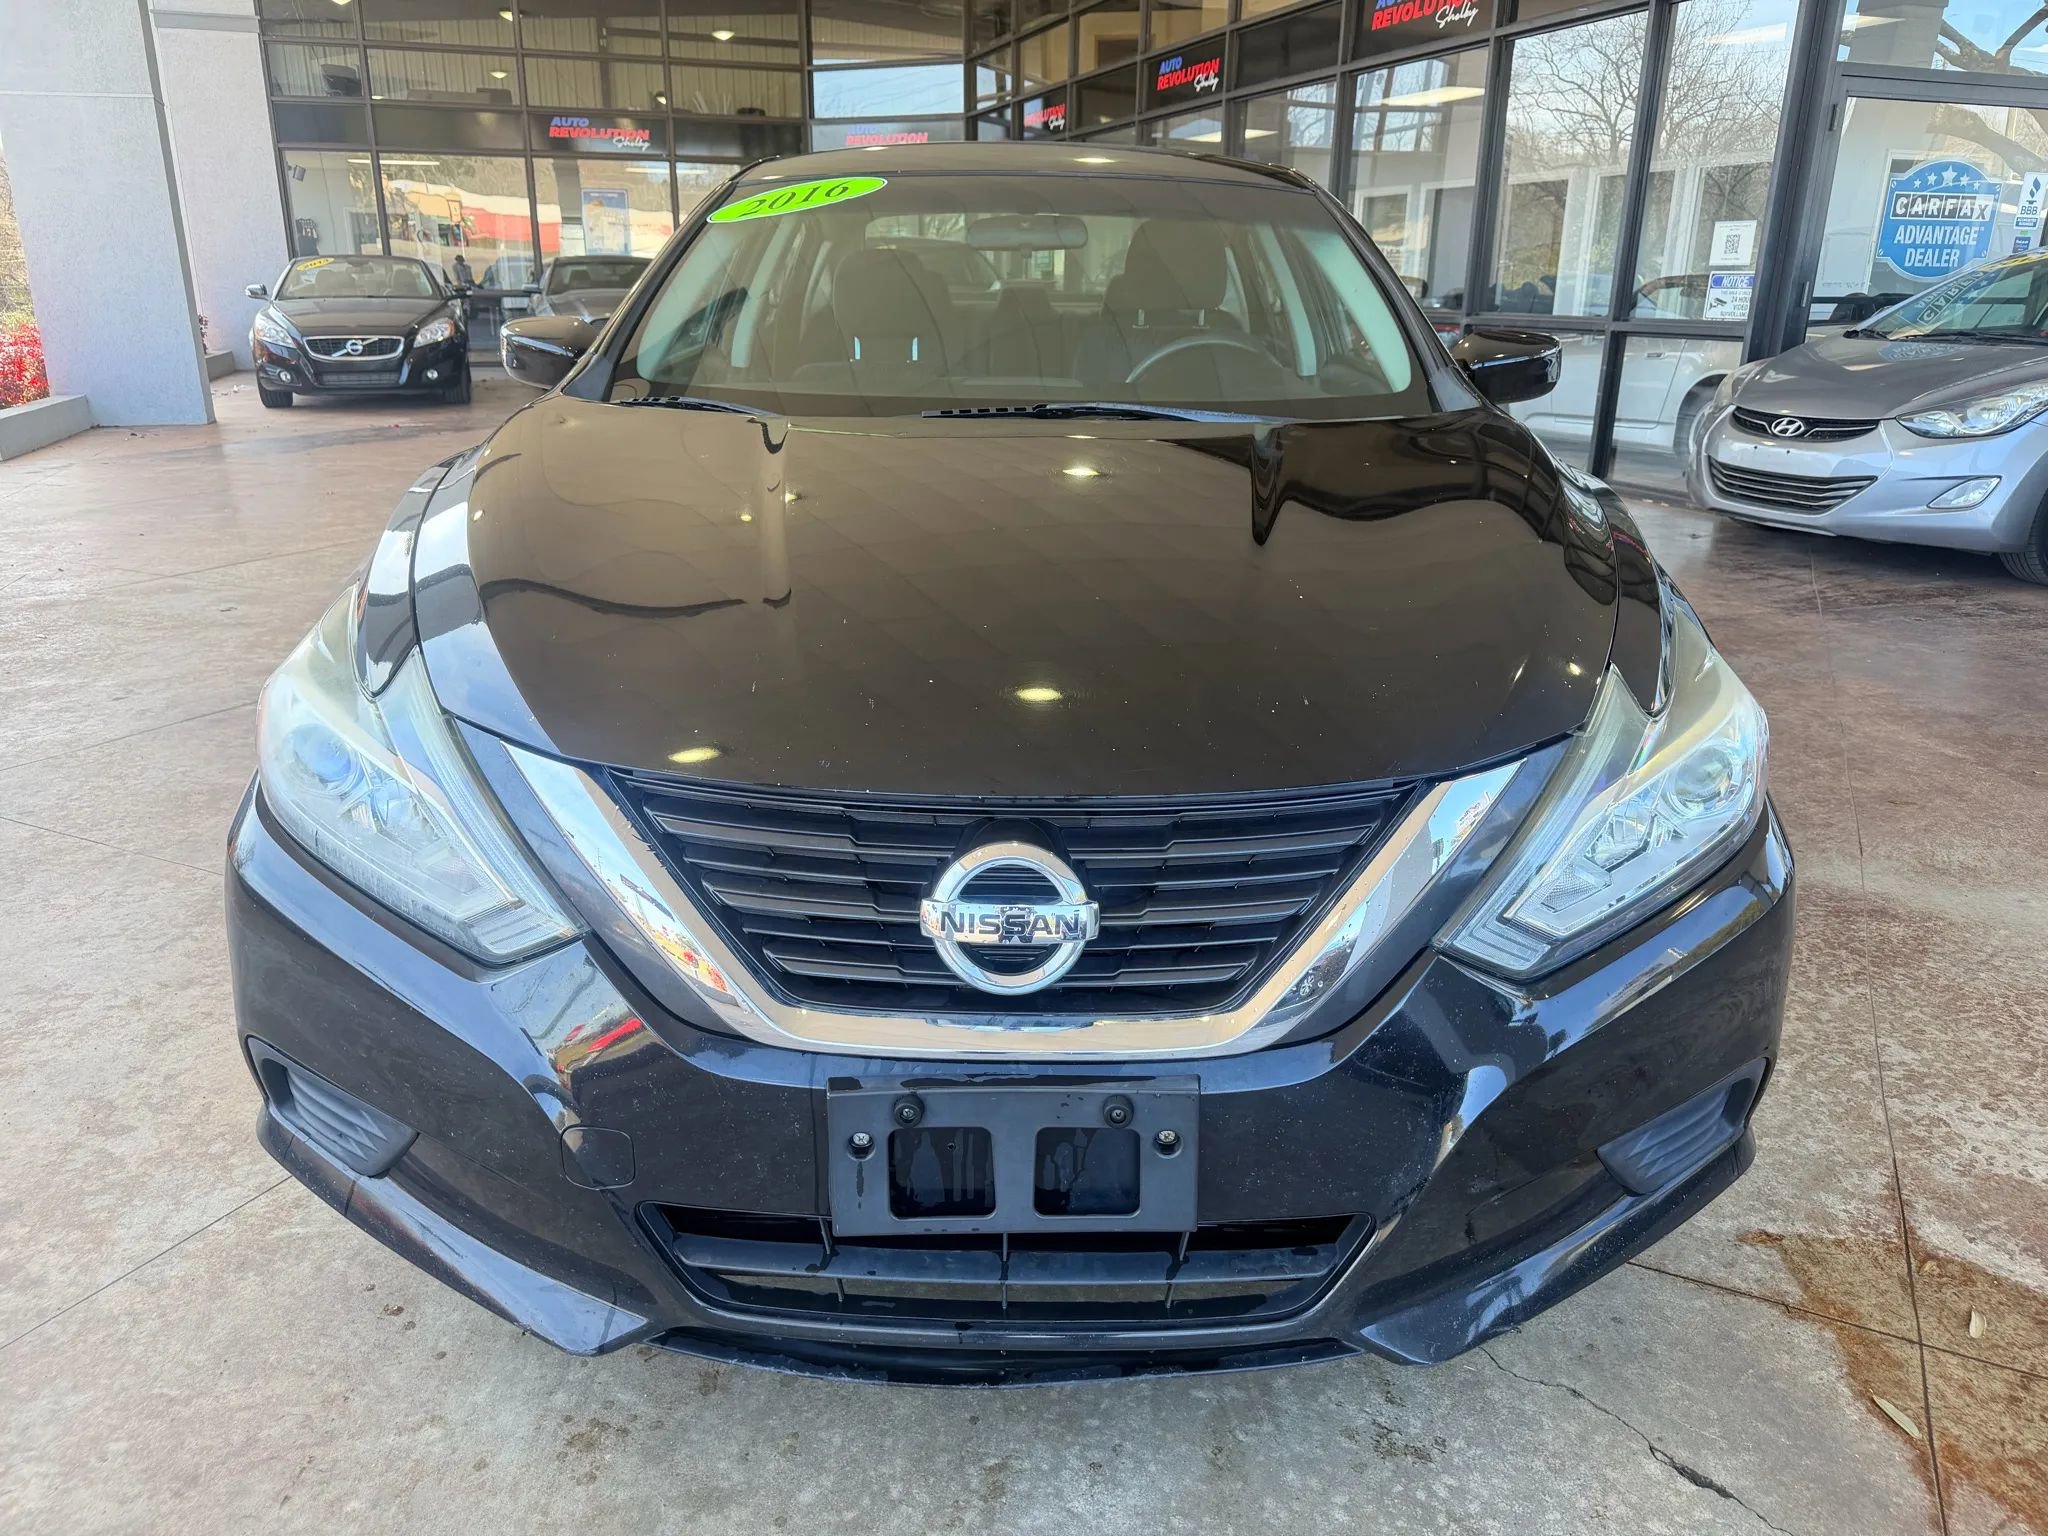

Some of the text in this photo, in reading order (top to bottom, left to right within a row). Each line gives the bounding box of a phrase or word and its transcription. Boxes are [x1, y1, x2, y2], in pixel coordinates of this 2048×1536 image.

[1435, 0, 1479, 29] Shelby
[1157, 58, 1220, 91] REVOLUTION
[1159, 56, 1183, 75] AUTO
[1193, 70, 1220, 92] Shelby
[550, 116, 590, 127] AUTO
[549, 126, 651, 140] REVOLUTION
[612, 135, 651, 152] Shelby
[738, 180, 851, 217] 2016
[1895, 196, 1990, 220] CARFAX
[2020, 205, 2038, 216] BBB
[1893, 225, 1979, 245] ADVANTAGE
[1904, 248, 1960, 267] DEALER
[1721, 275, 1750, 287] NOTICE
[940, 911, 1080, 937] NISSAN
